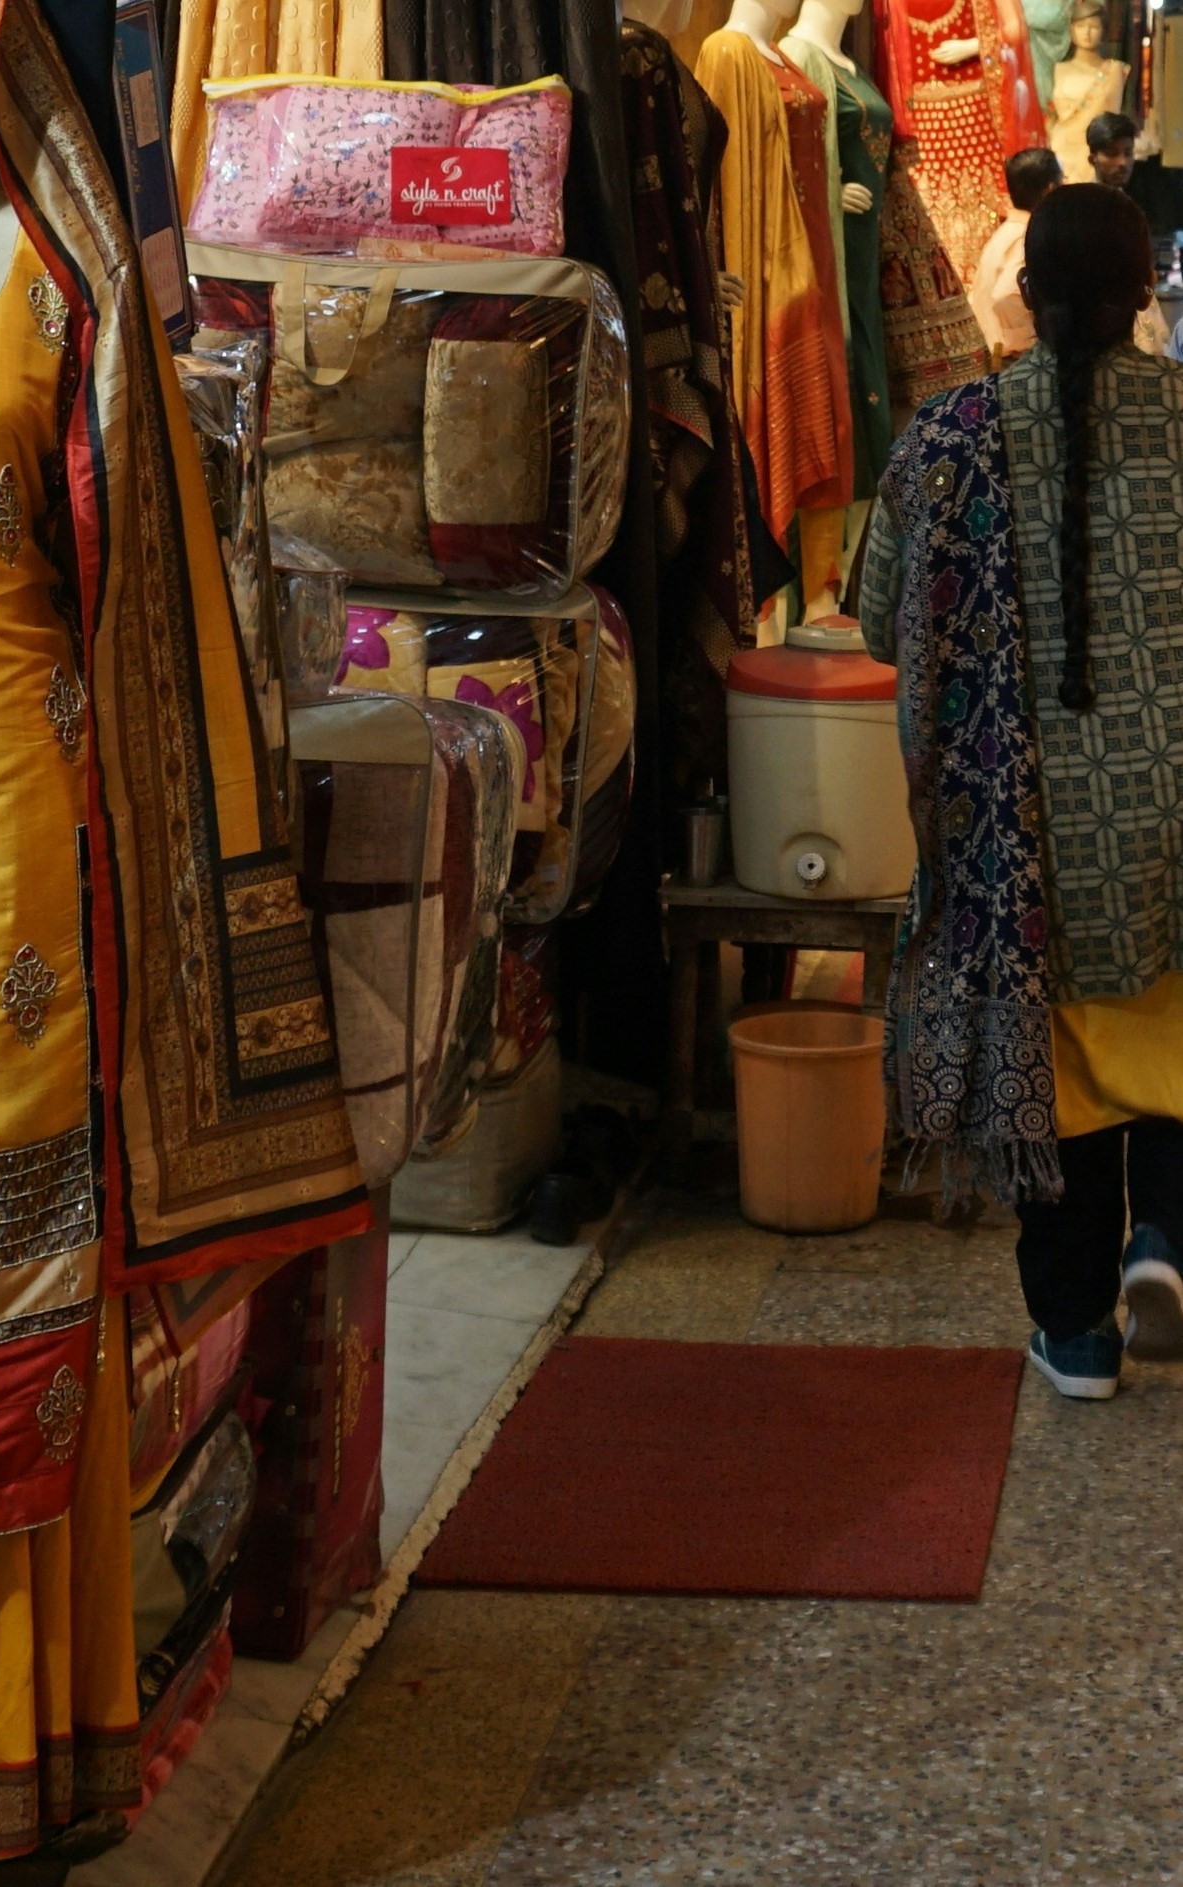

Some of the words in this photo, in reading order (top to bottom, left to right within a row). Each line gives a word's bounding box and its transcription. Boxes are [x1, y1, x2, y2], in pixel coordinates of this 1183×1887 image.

[400, 177, 439, 216] style
[444, 188, 456, 201] n
[461, 181, 504, 216] craft
